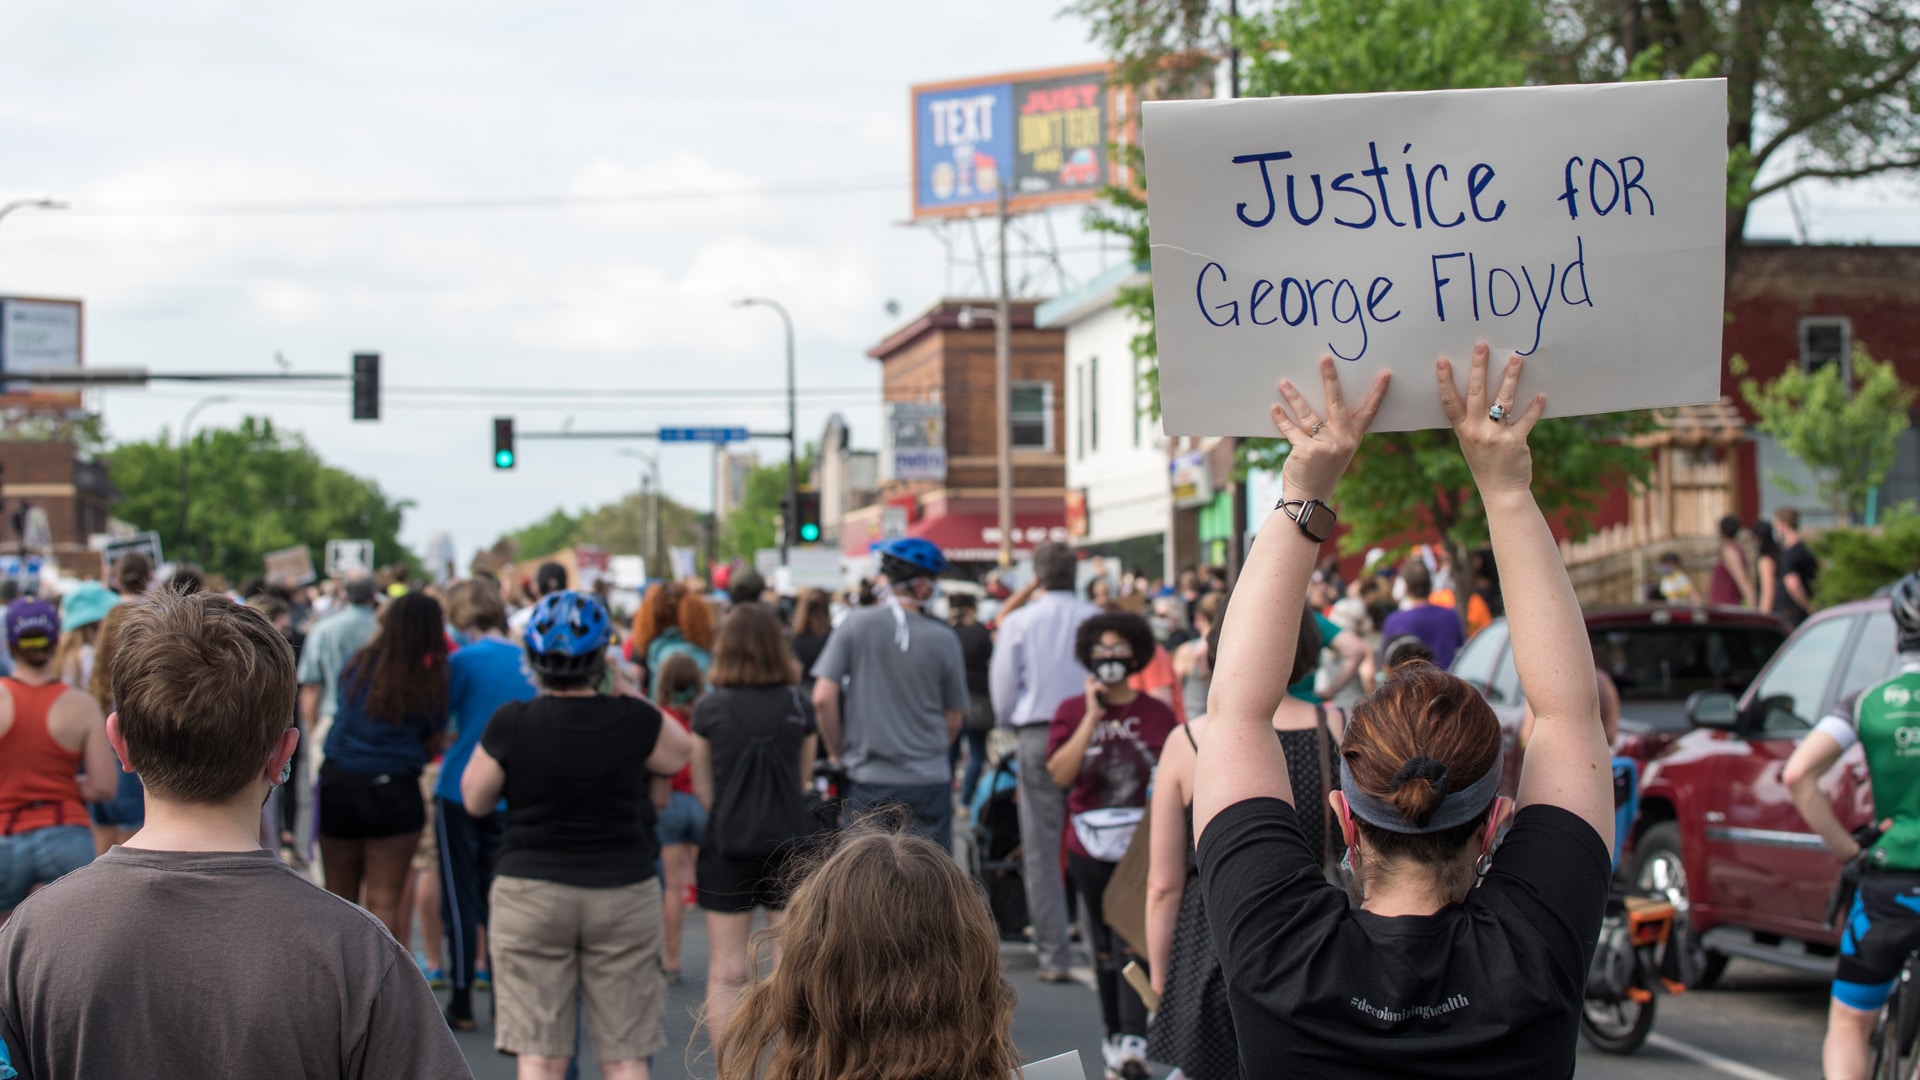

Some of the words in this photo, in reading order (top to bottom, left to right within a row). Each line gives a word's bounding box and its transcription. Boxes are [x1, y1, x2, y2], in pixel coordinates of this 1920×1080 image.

[929, 94, 997, 147] TEXT
[1020, 83, 1100, 114] JUST
[1232, 141, 1507, 230] Justice
[1196, 261, 1401, 362] George
[1431, 235, 1594, 357] Floyd
[1350, 993, 1470, 1022] #decolonizingwealth
